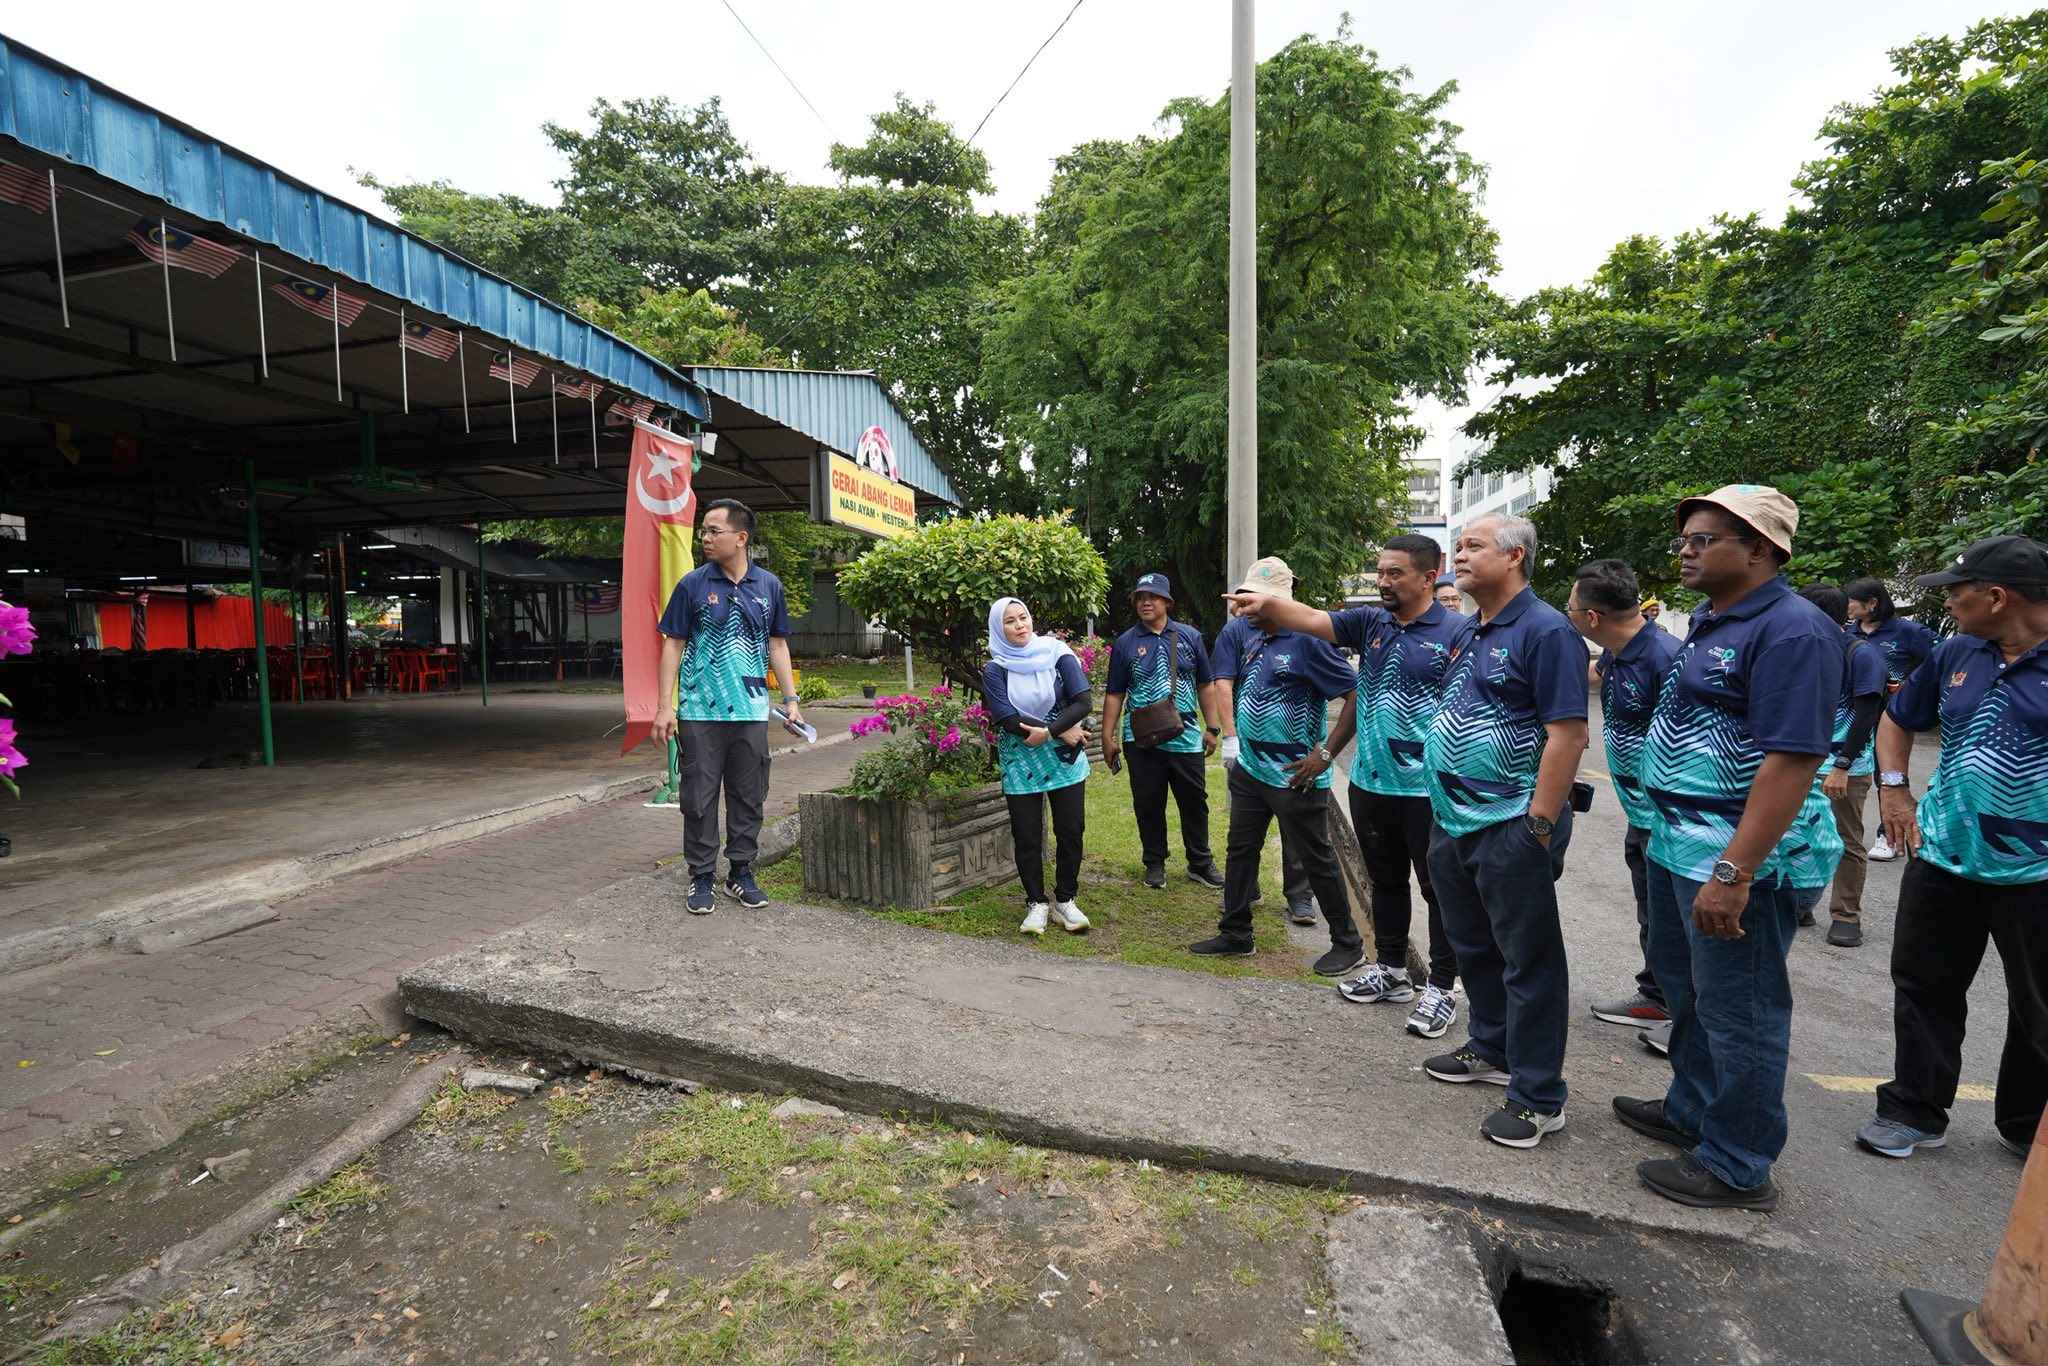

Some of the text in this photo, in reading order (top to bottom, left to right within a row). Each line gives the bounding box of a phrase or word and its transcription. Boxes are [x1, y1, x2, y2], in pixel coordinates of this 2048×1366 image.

[832, 470, 913, 517] GERAI ABANG LEMAN
[839, 497, 856, 512] NASI
[857, 504, 875, 519] AYAM
